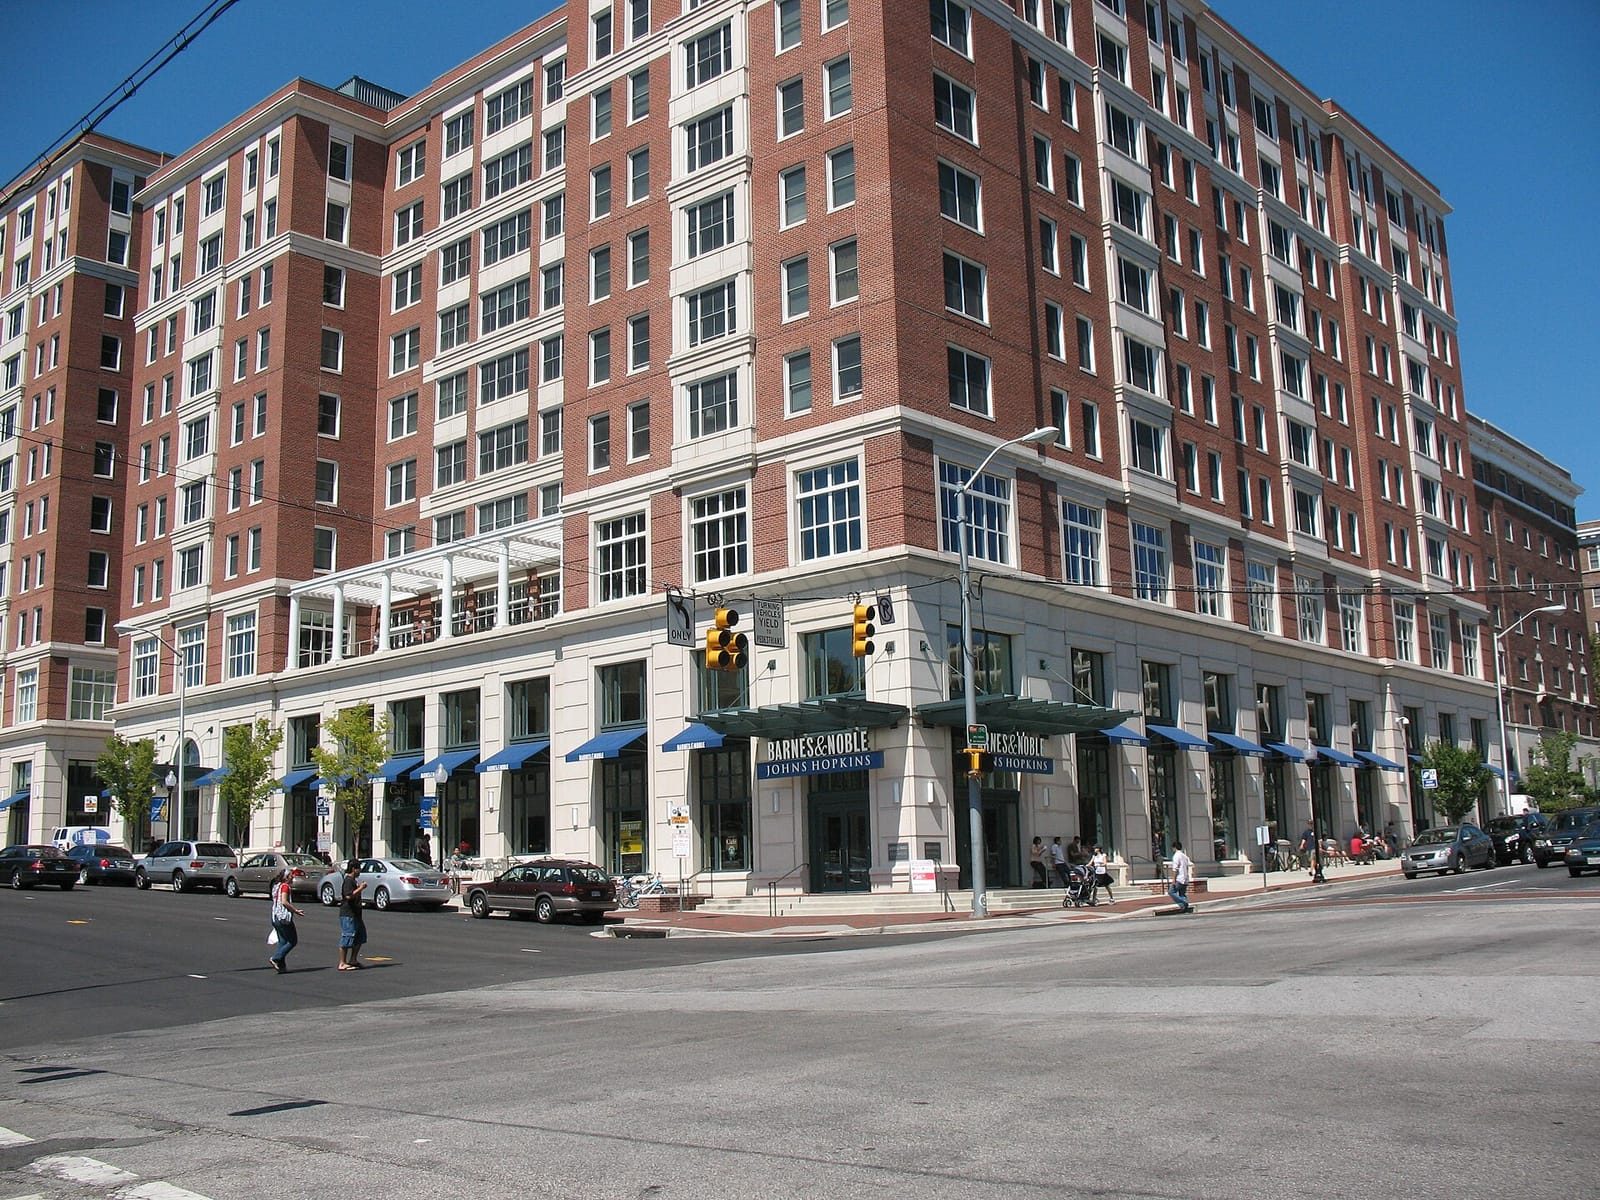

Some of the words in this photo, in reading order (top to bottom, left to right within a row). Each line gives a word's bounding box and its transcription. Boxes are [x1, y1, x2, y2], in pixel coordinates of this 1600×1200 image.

[757, 601, 780, 610] TURNING
[756, 608, 781, 618] VEHICLES
[759, 617, 779, 628] YIELD
[671, 629, 692, 641] ONLY
[767, 731, 868, 761] BARNES&NOBLE
[978, 733, 1045, 757] RNES&NOBLE
[766, 761, 807, 777] JOHNS
[811, 755, 871, 771] HOPKINS
[1006, 757, 1048, 770] HOPKINS
